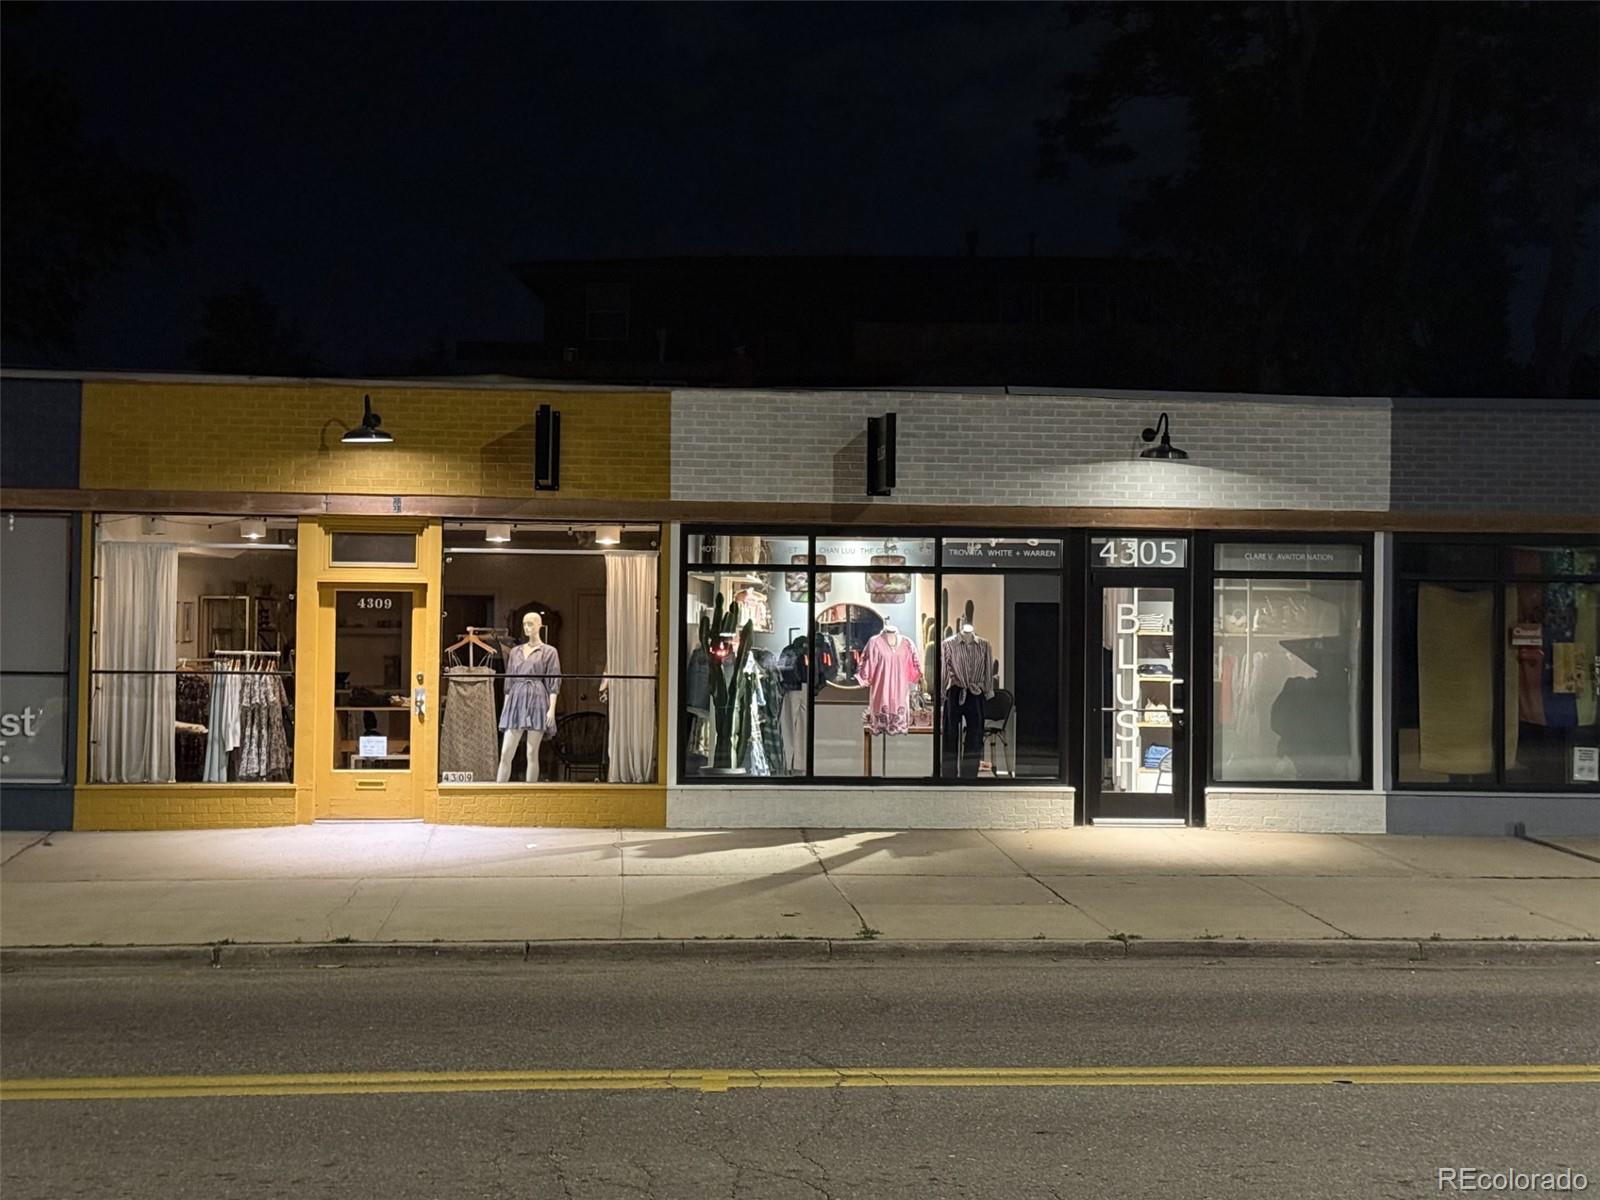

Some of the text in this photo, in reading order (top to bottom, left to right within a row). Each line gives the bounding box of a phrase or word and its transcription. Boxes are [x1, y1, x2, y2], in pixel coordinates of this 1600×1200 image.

[1099, 541, 1177, 565] 4305
[1244, 553, 1266, 561] CLARE
[1307, 553, 1334, 561] NATION
[357, 598, 392, 609] 4309
[1116, 603, 1140, 777] BLUSH
[443, 773, 472, 783] 4309
